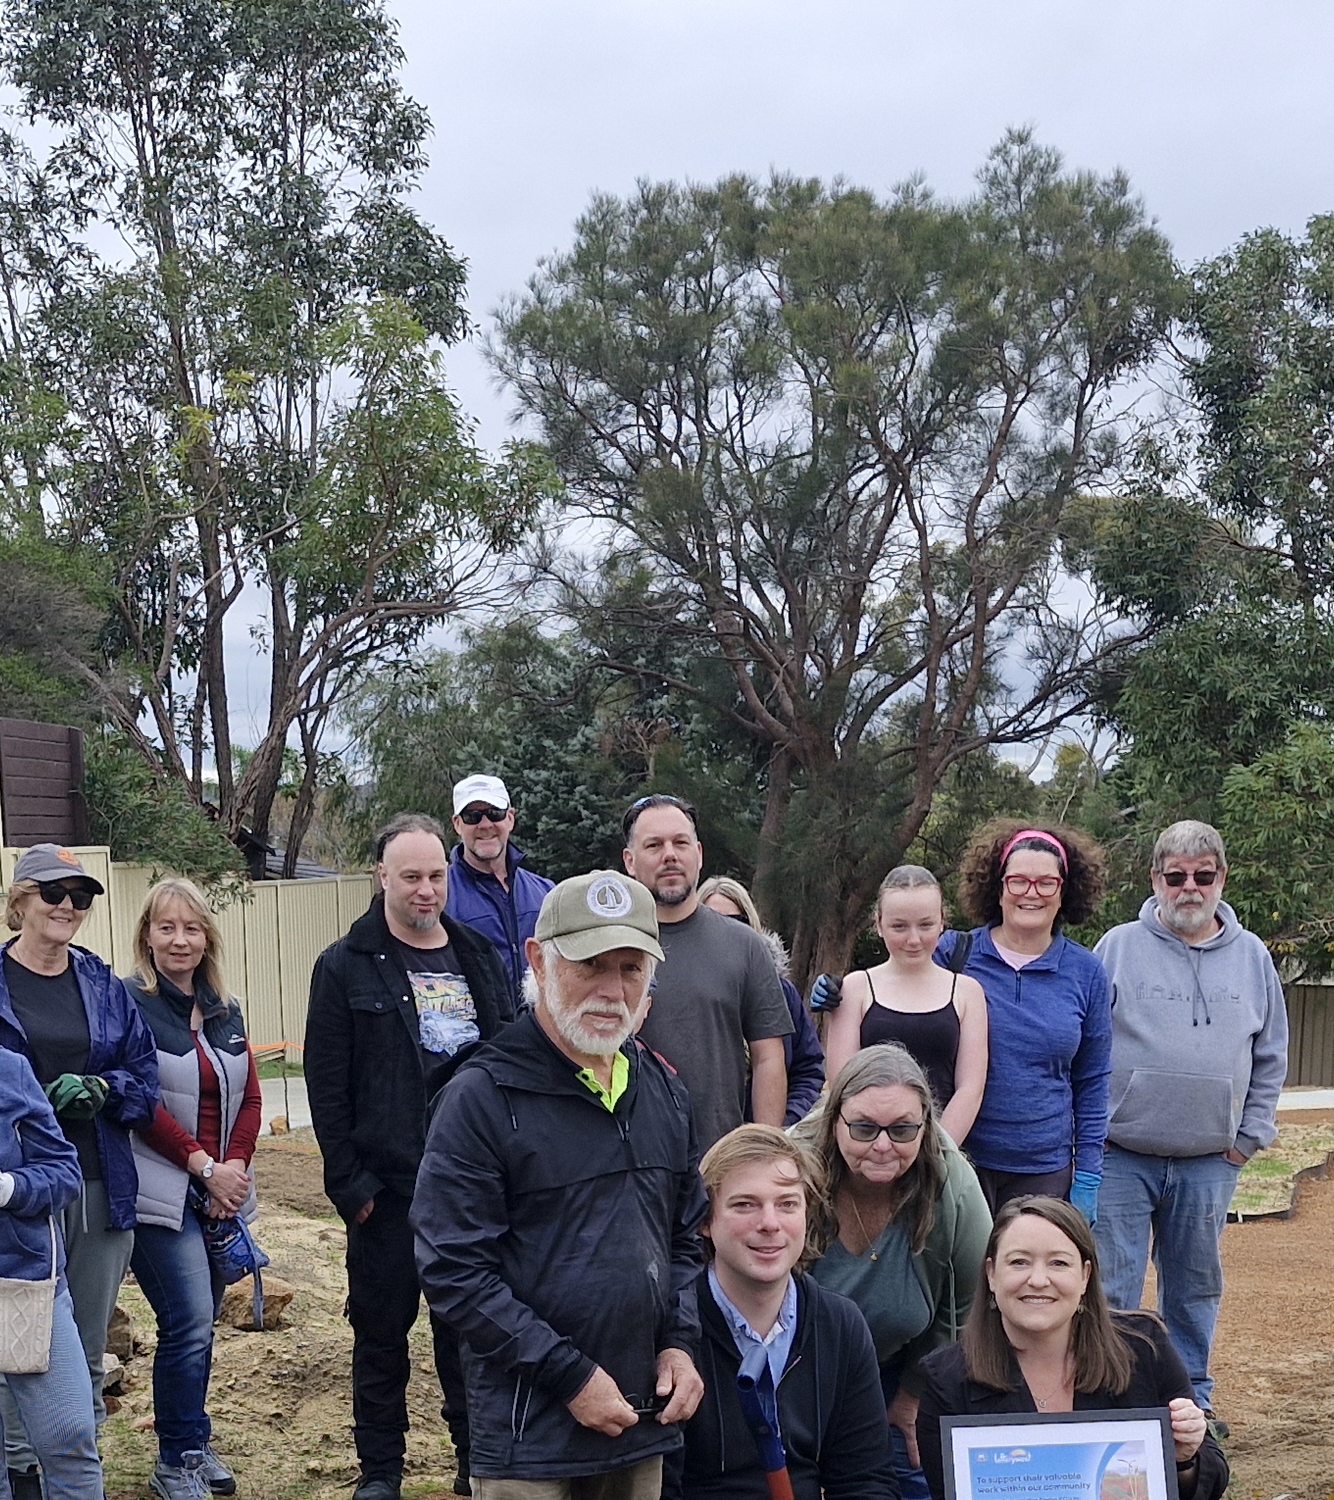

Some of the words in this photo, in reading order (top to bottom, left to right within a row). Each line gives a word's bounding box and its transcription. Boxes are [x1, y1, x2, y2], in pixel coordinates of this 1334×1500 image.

[988, 1476, 1021, 1485] support
[1044, 1473, 1082, 1481] valuable
[977, 1486, 998, 1494] work
[1000, 1484, 1026, 1493] within
[1043, 1482, 1091, 1491] community
